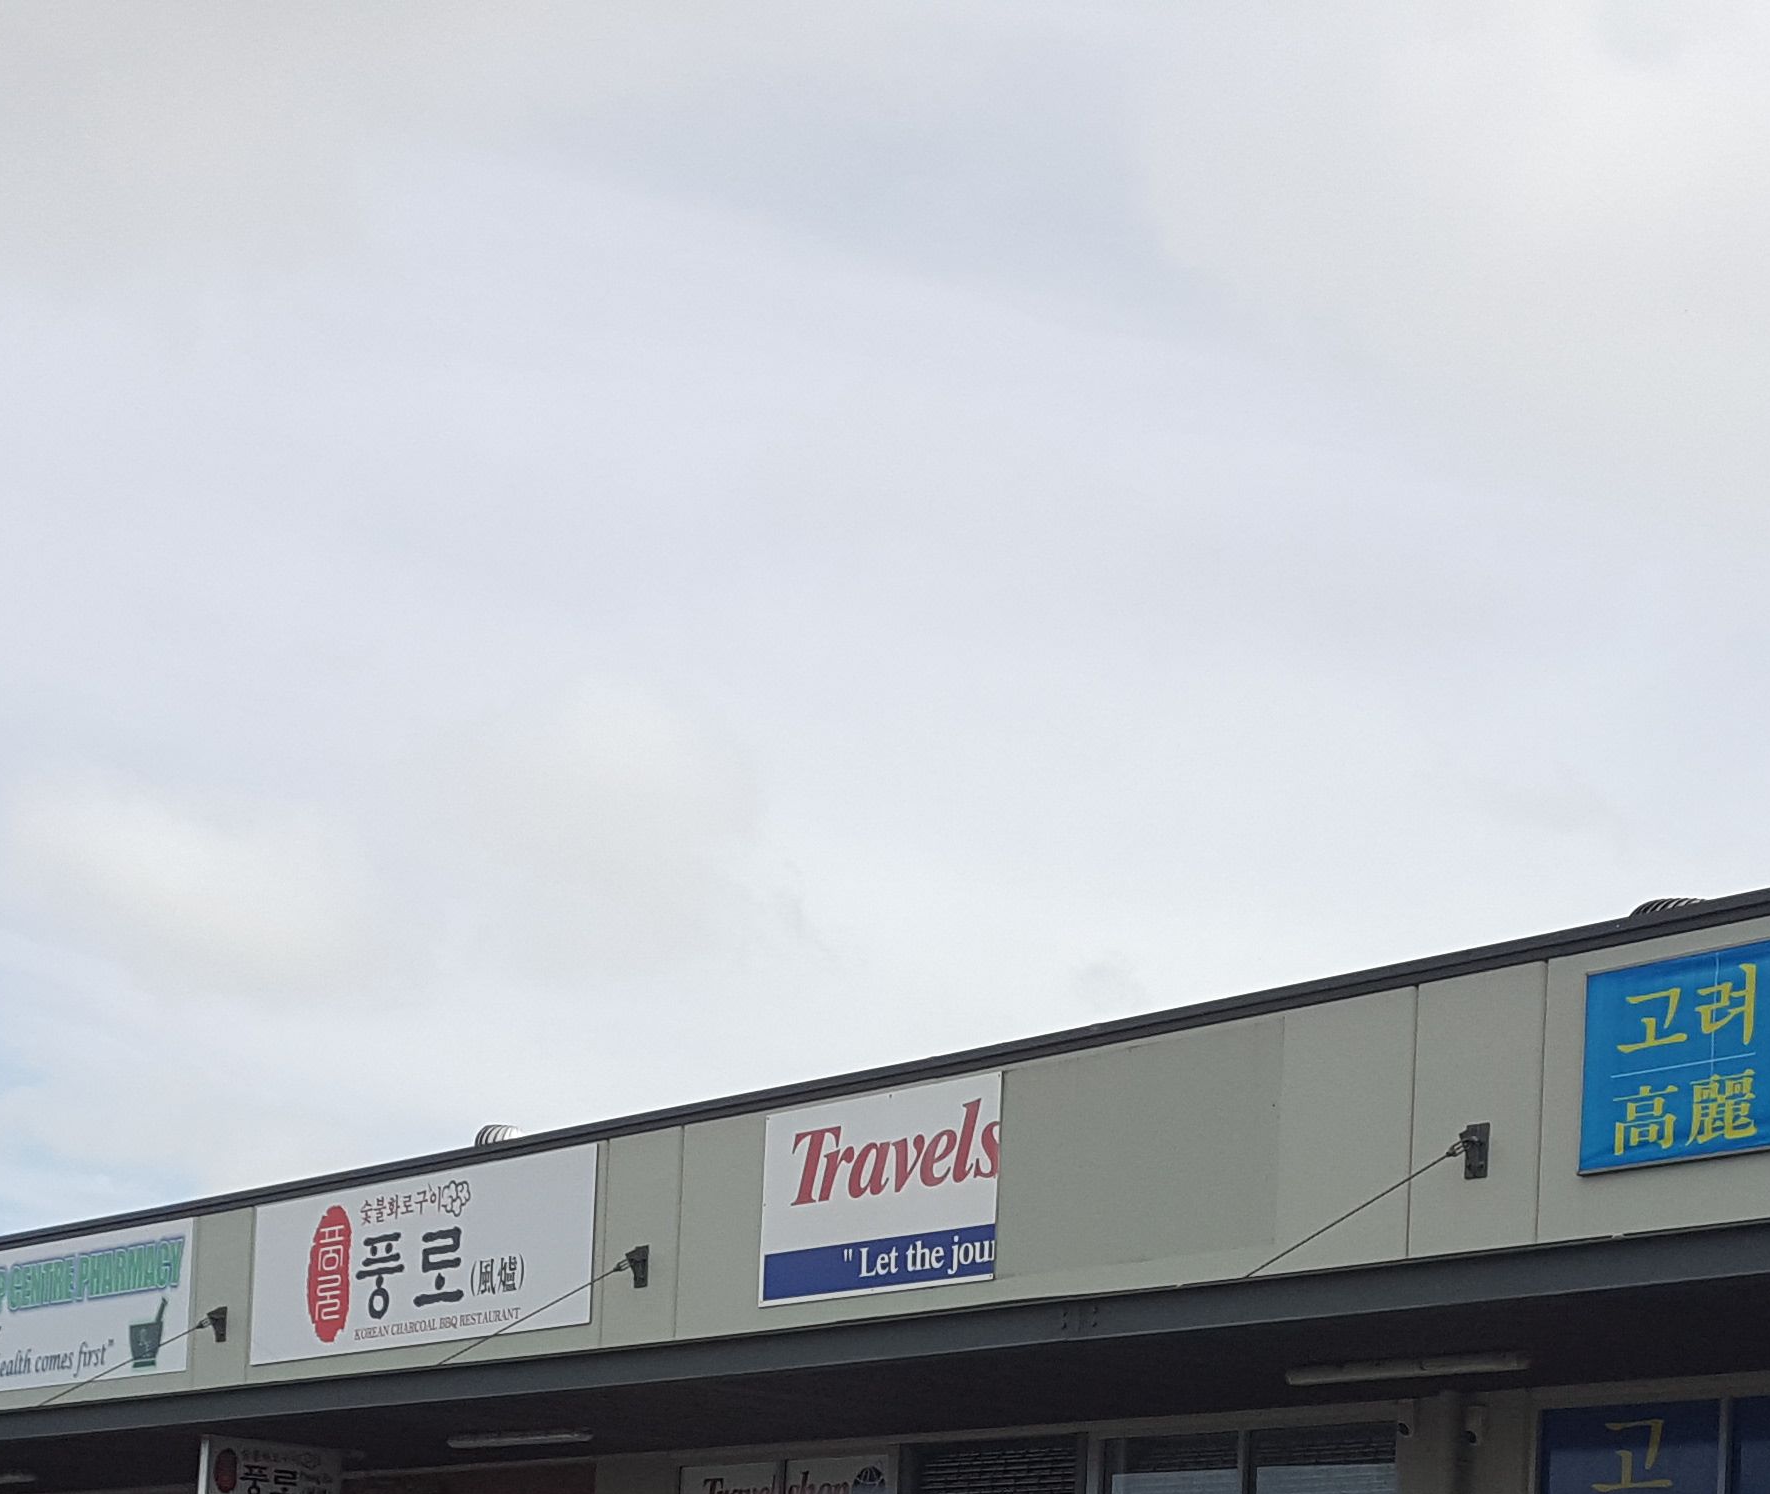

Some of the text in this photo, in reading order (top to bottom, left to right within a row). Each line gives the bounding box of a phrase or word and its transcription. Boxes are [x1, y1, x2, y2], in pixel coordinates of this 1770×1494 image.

[1615, 962, 1756, 1058] 고려
[1615, 1070, 1756, 1158] 高麗
[8, 1253, 75, 1312] CENTRE
[77, 1236, 185, 1301] PHARMACY
[355, 1226, 464, 1320] 풍로
[859, 1247, 899, 1278] Let
[906, 1241, 944, 1273] the
[35, 1351, 73, 1373] comes
[354, 1307, 521, 1341] KOREAN CHARCOAL BBQ RESTAURANT
